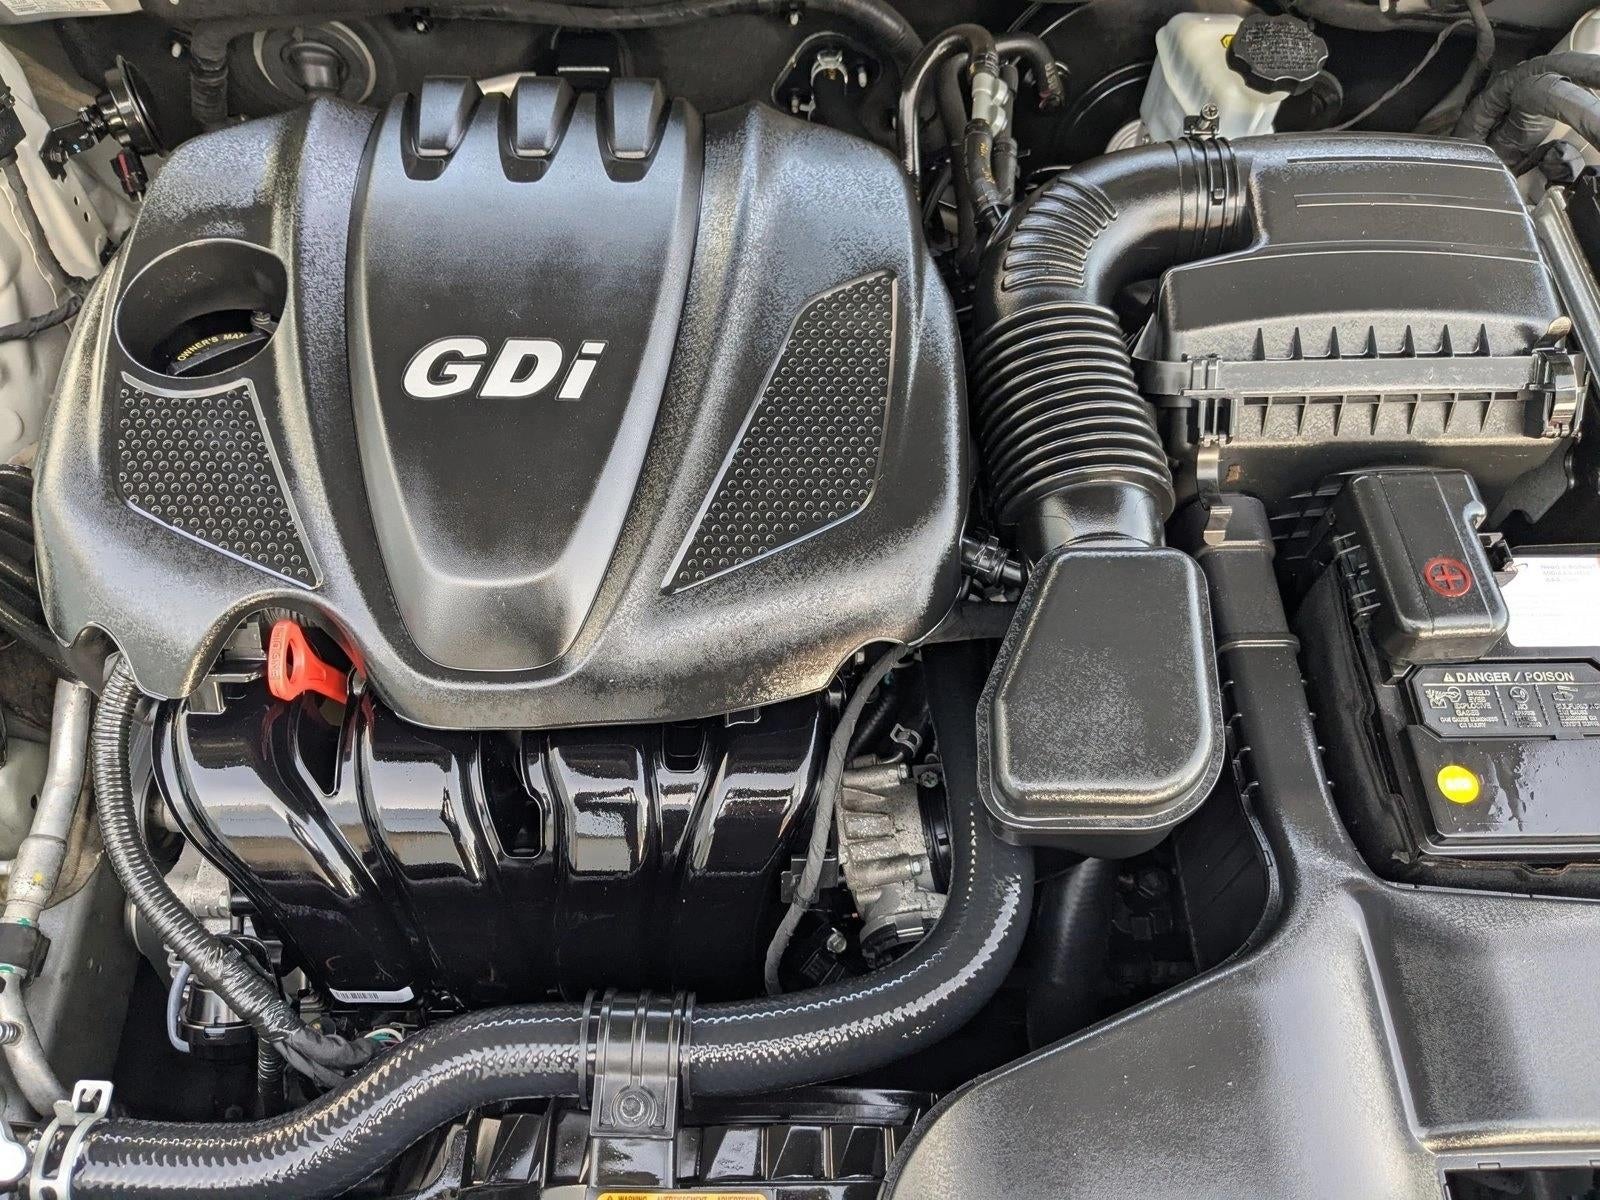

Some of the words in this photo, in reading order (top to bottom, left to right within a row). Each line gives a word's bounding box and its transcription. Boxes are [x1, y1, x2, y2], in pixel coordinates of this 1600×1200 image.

[177, 336, 219, 361] OWNER'S
[401, 335, 609, 400] GDi
[1456, 672, 1511, 682] DANGER
[1525, 671, 1575, 682] POISON
